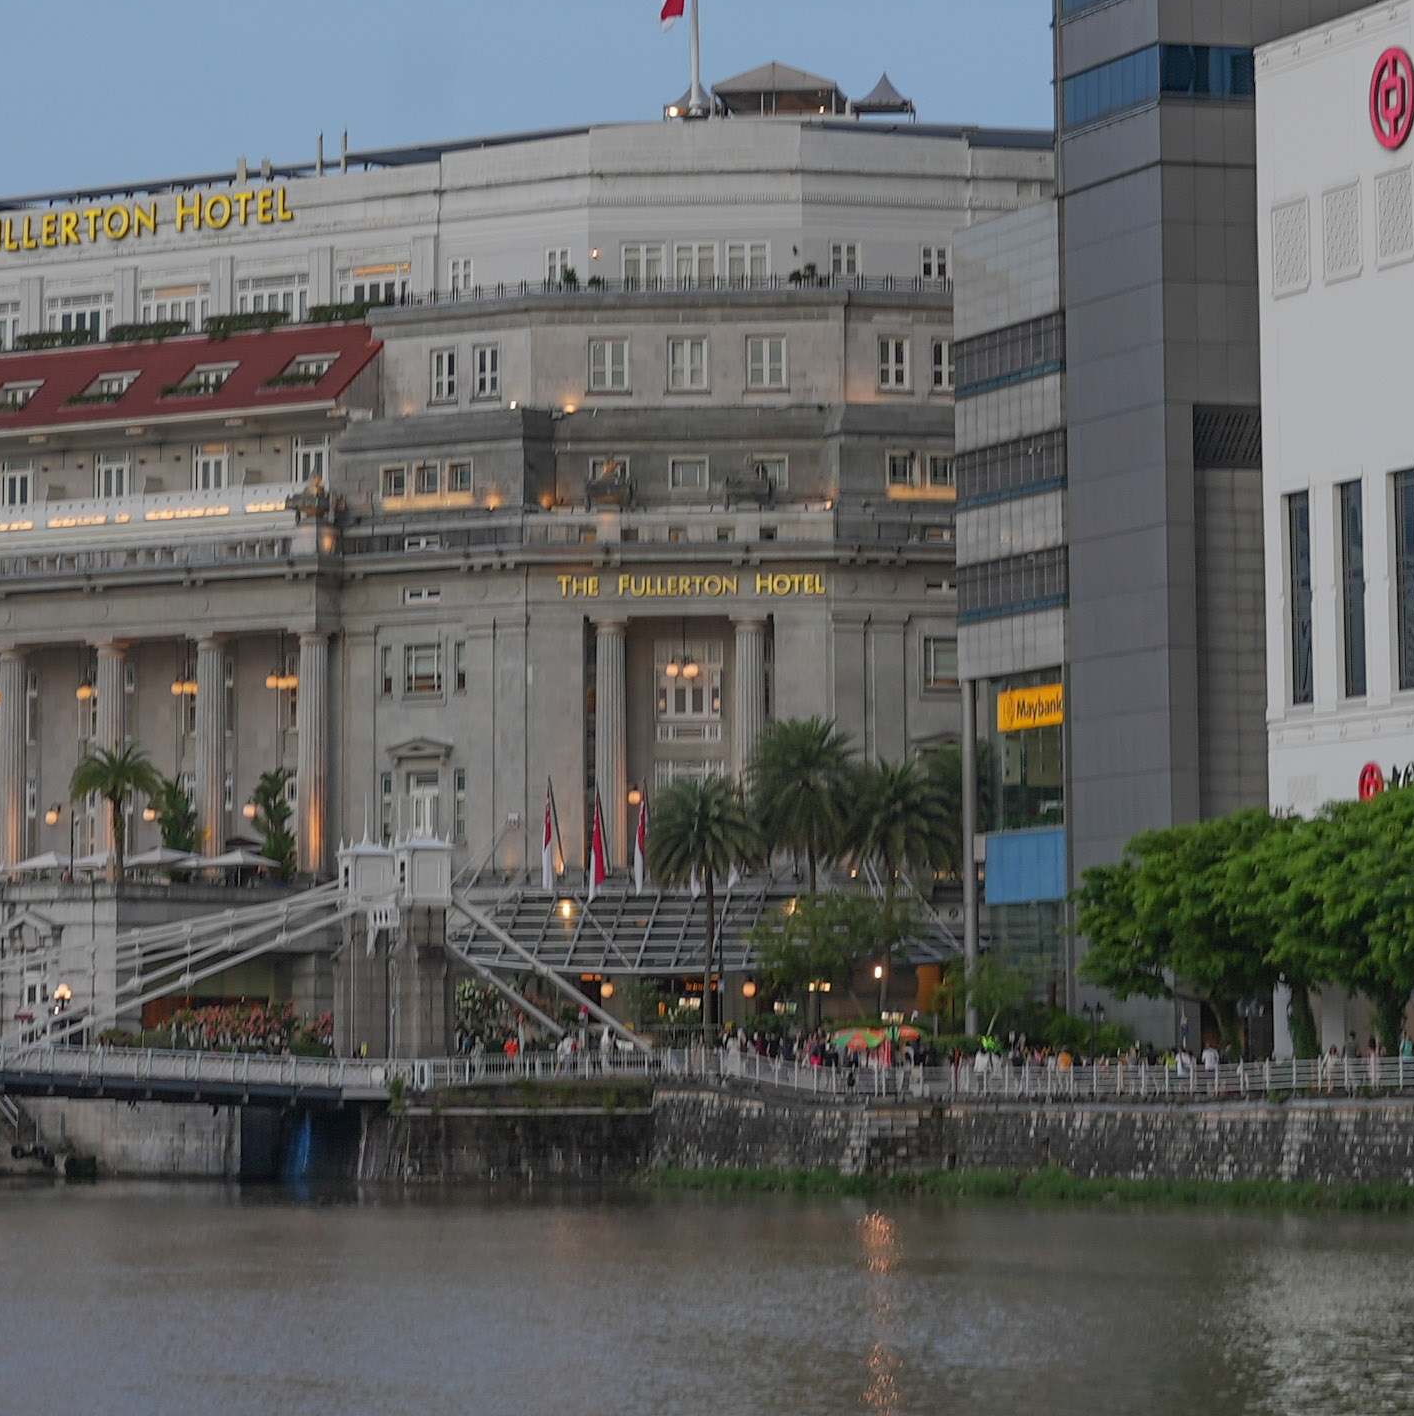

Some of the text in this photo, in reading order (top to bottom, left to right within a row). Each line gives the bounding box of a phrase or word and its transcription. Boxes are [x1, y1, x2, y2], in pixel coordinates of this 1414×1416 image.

[175, 186, 294, 232] HOTEL
[557, 572, 826, 597] THE FULLERTON HOTEL
[1016, 692, 1064, 726] Maybank
